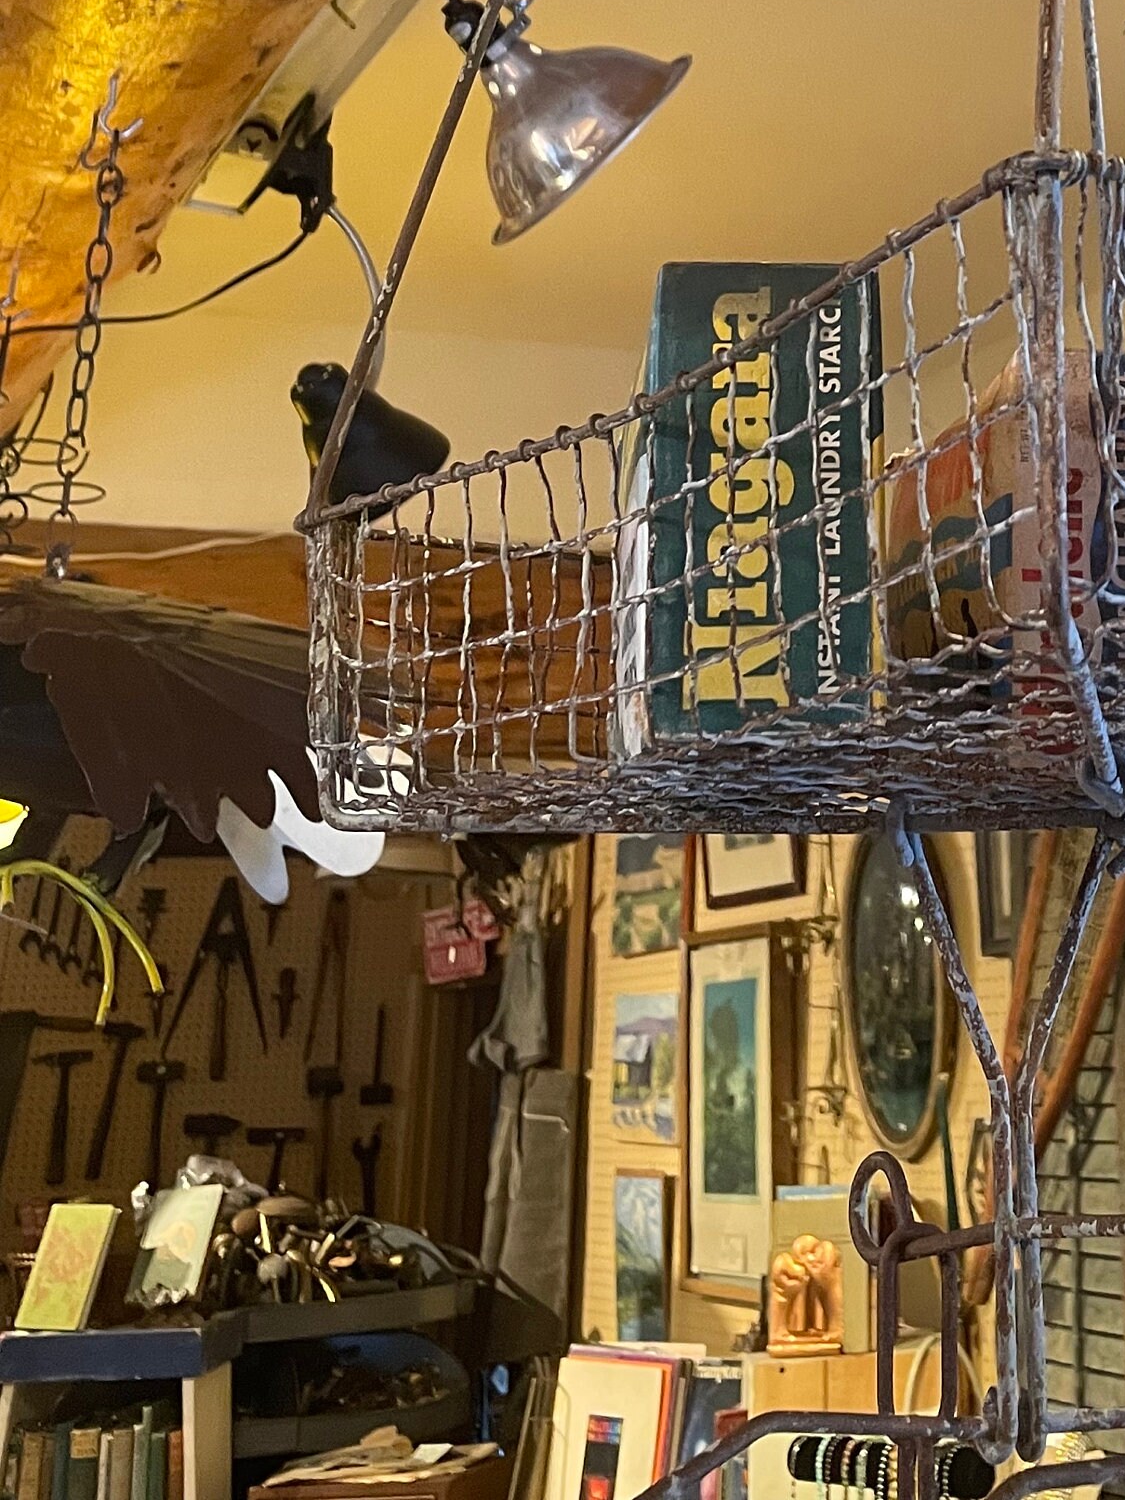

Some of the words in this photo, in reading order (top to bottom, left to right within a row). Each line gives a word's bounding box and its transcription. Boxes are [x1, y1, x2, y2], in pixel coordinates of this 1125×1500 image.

[818, 299, 843, 393] STARC
[682, 286, 796, 711] Niagara
[817, 411, 844, 557] LAUNDRY
[817, 571, 844, 696] NSTANT
